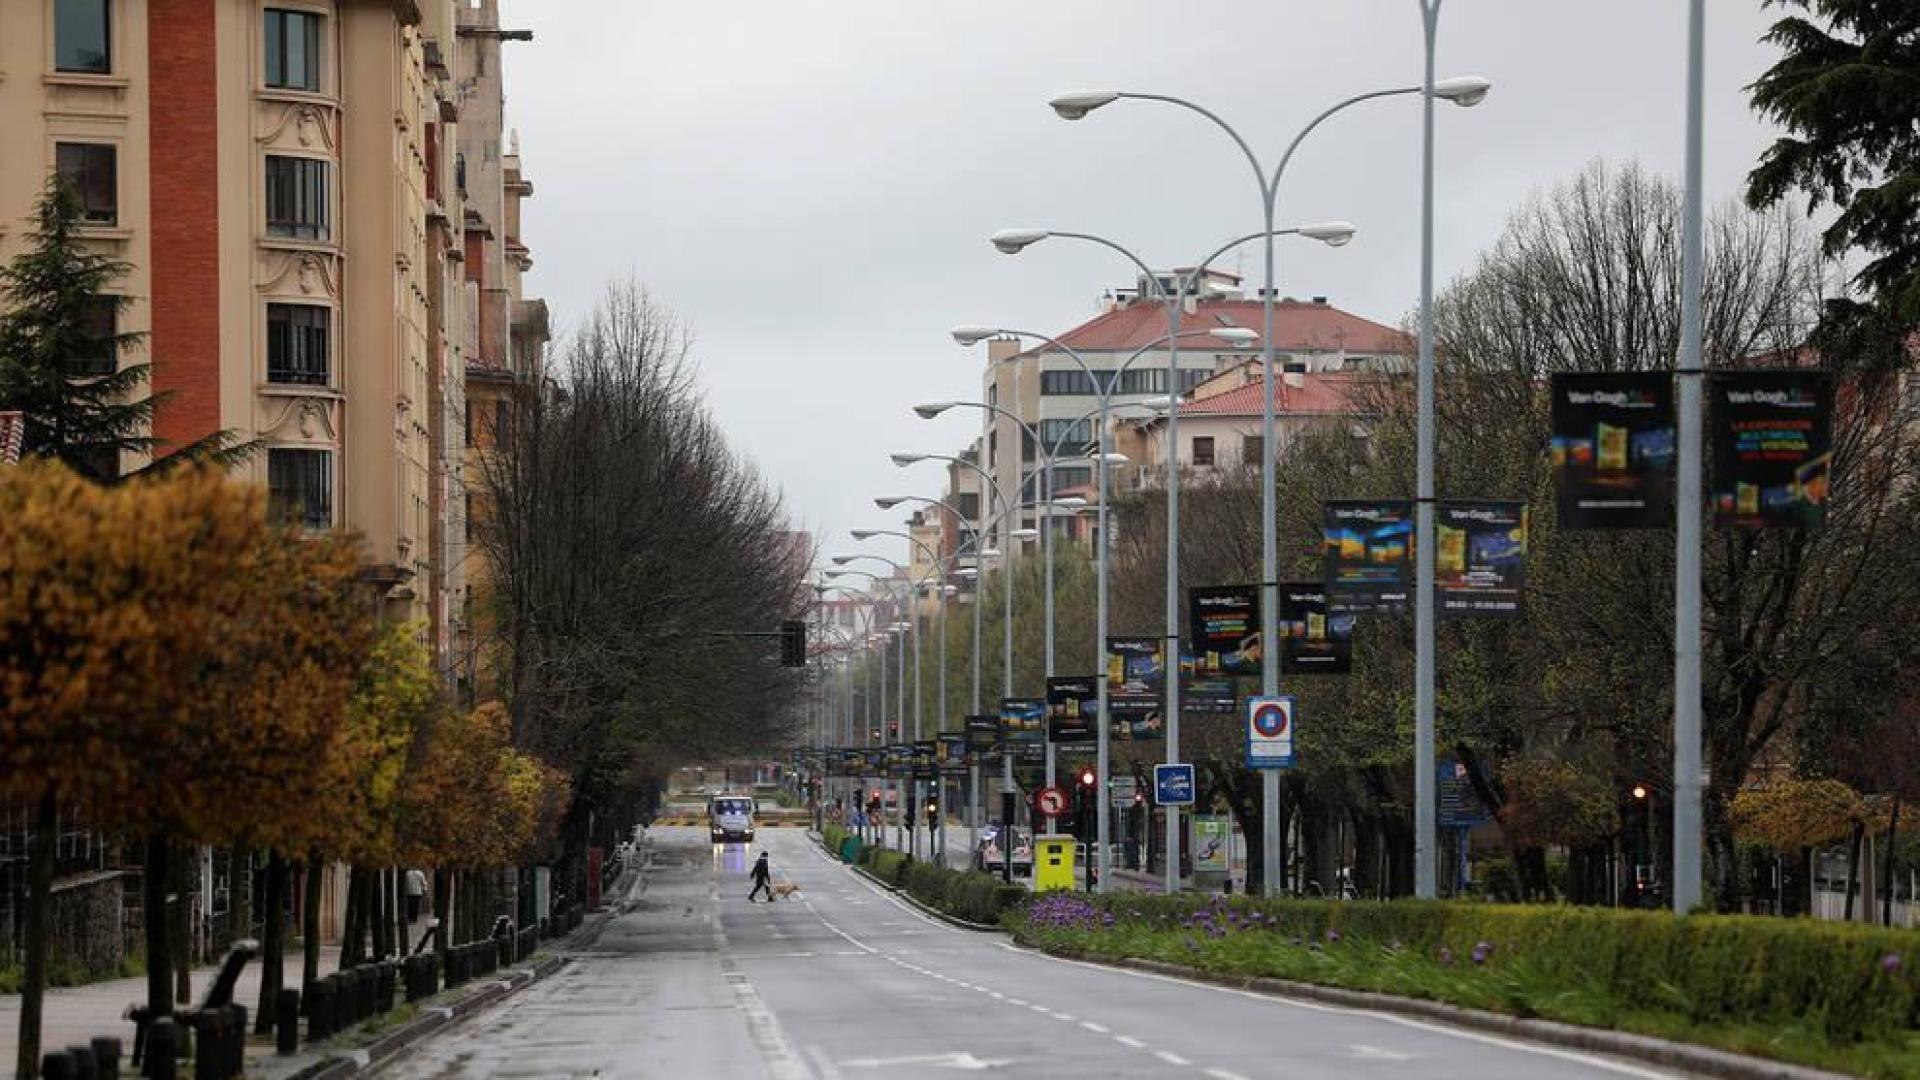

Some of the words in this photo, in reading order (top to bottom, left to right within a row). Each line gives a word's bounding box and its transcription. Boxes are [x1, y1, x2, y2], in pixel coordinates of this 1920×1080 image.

[1567, 391, 1591, 403] Van
[1593, 391, 1627, 405] Gogh
[1727, 391, 1752, 403] Van
[1753, 391, 1788, 405] Gogh
